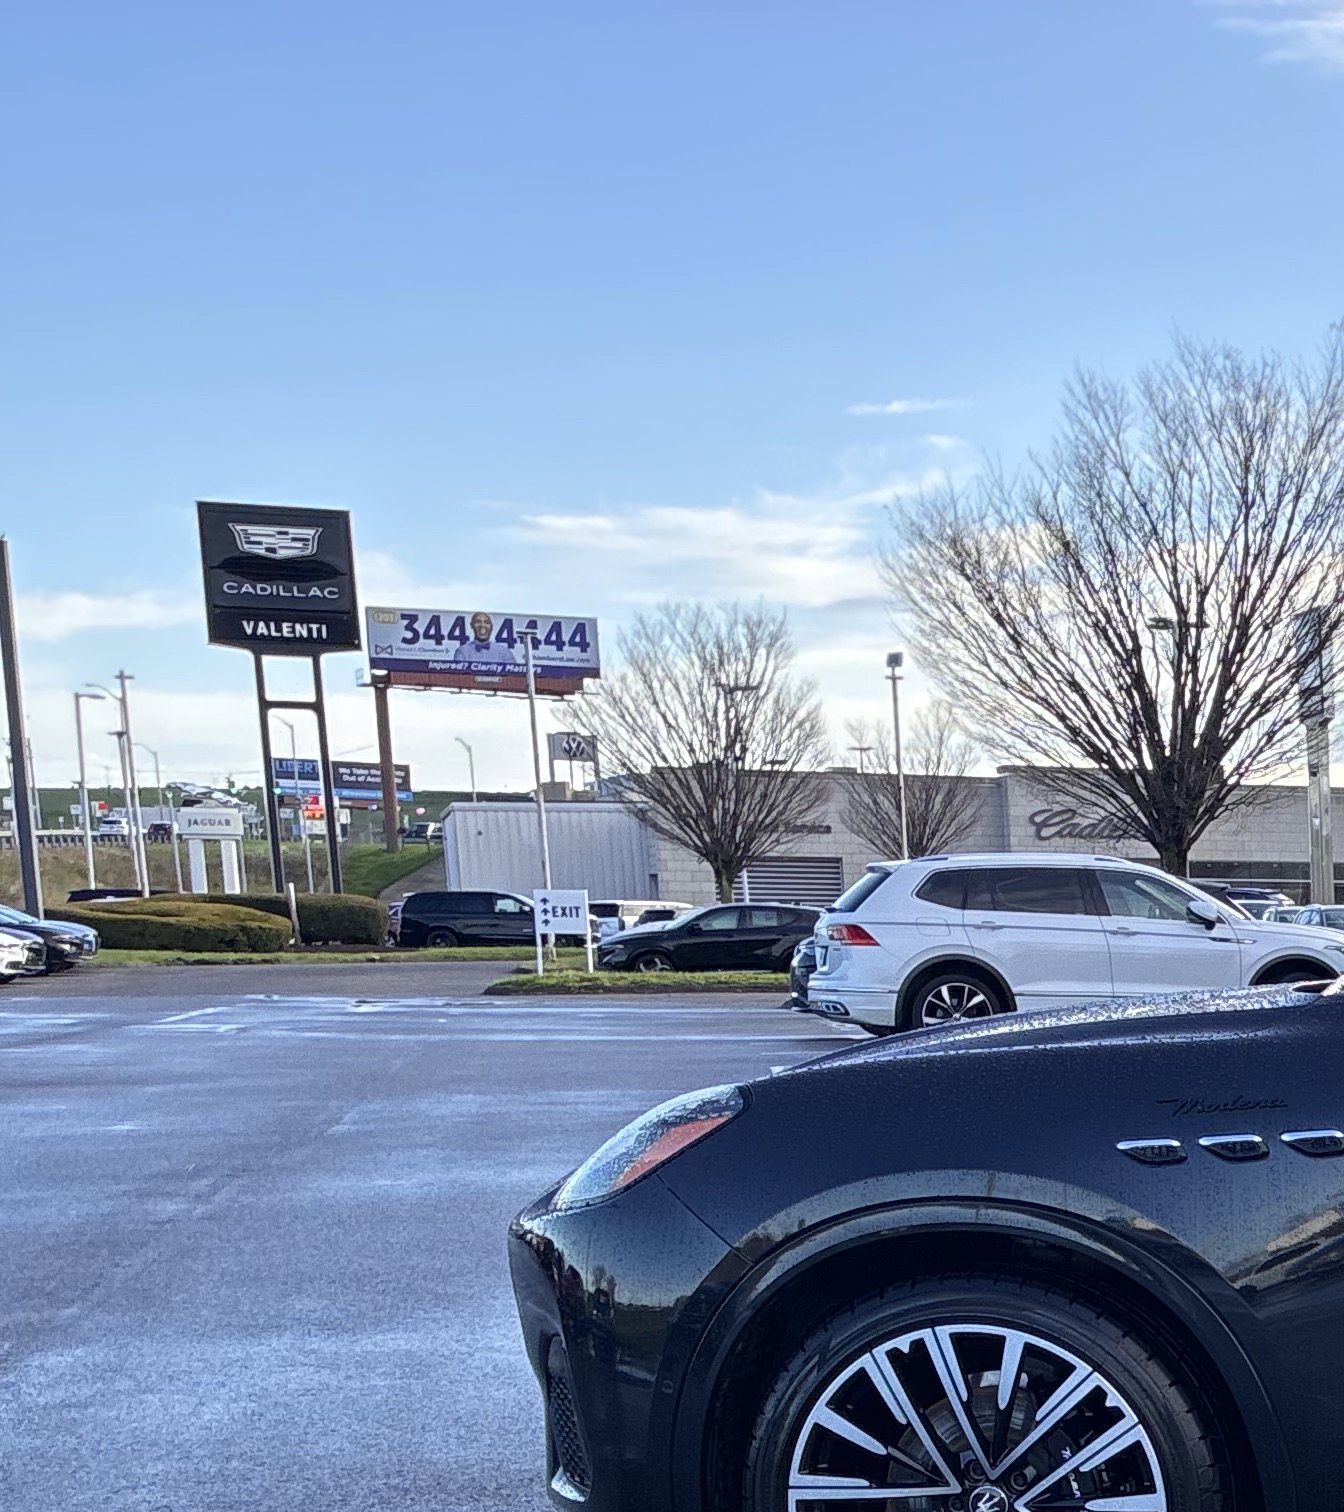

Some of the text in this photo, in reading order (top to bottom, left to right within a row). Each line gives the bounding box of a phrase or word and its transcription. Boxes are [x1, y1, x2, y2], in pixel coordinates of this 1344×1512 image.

[223, 582, 340, 599] CADILLAC
[242, 620, 328, 639] VALENTI
[400, 613, 470, 646] 344
[429, 661, 541, 674] Injured? Clarity Mattrs
[187, 818, 231, 828] JAGUAR
[551, 905, 581, 918] EXIT
